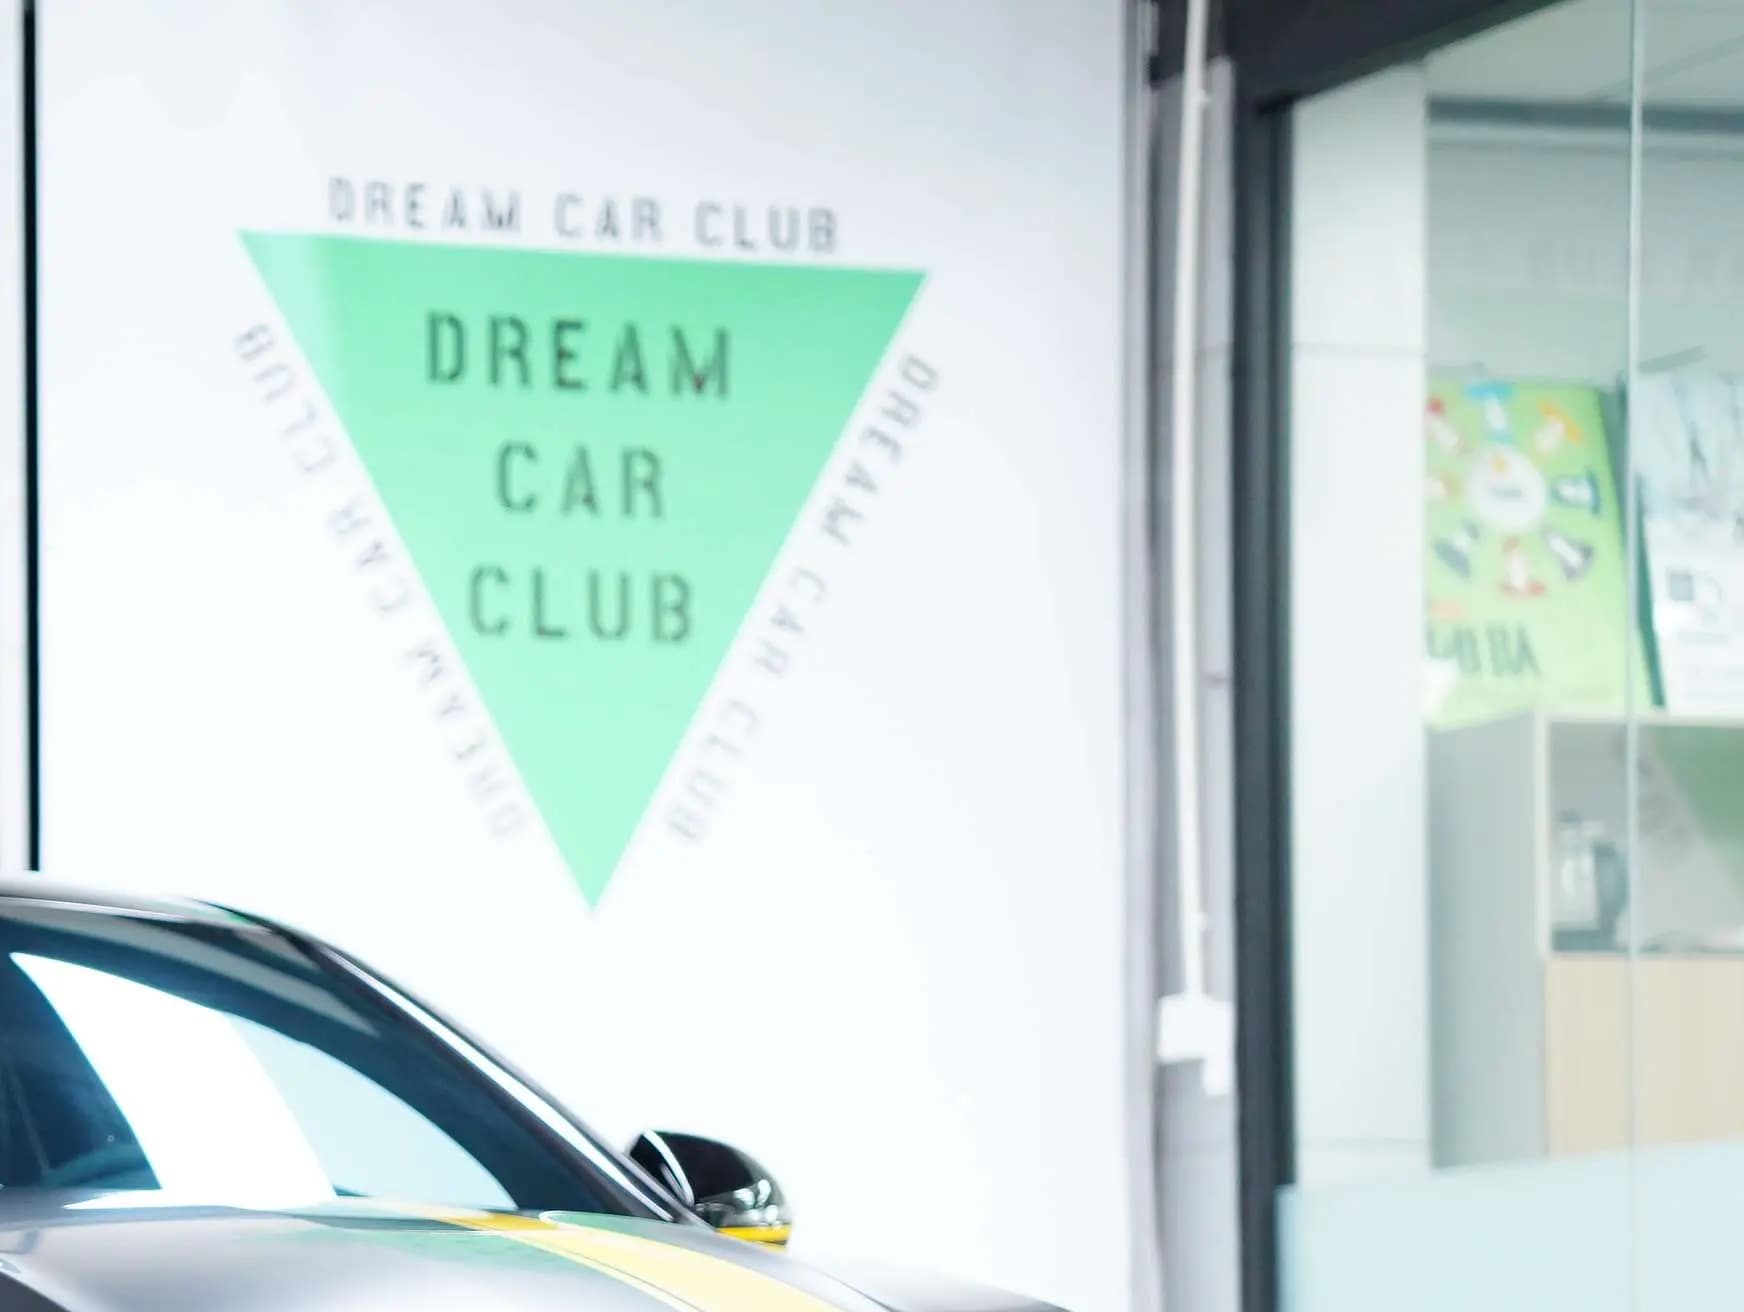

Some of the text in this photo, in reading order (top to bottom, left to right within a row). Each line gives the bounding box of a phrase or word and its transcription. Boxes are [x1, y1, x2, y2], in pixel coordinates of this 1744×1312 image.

[327, 176, 840, 255] DREAM CAR CLUB
[427, 310, 732, 400] DREAM
[232, 324, 340, 478] CLUB
[495, 440, 665, 520] CAR
[326, 496, 412, 618] CAR
[666, 353, 940, 844] DREAM CAR CLUB
[468, 563, 695, 644] CLUB
